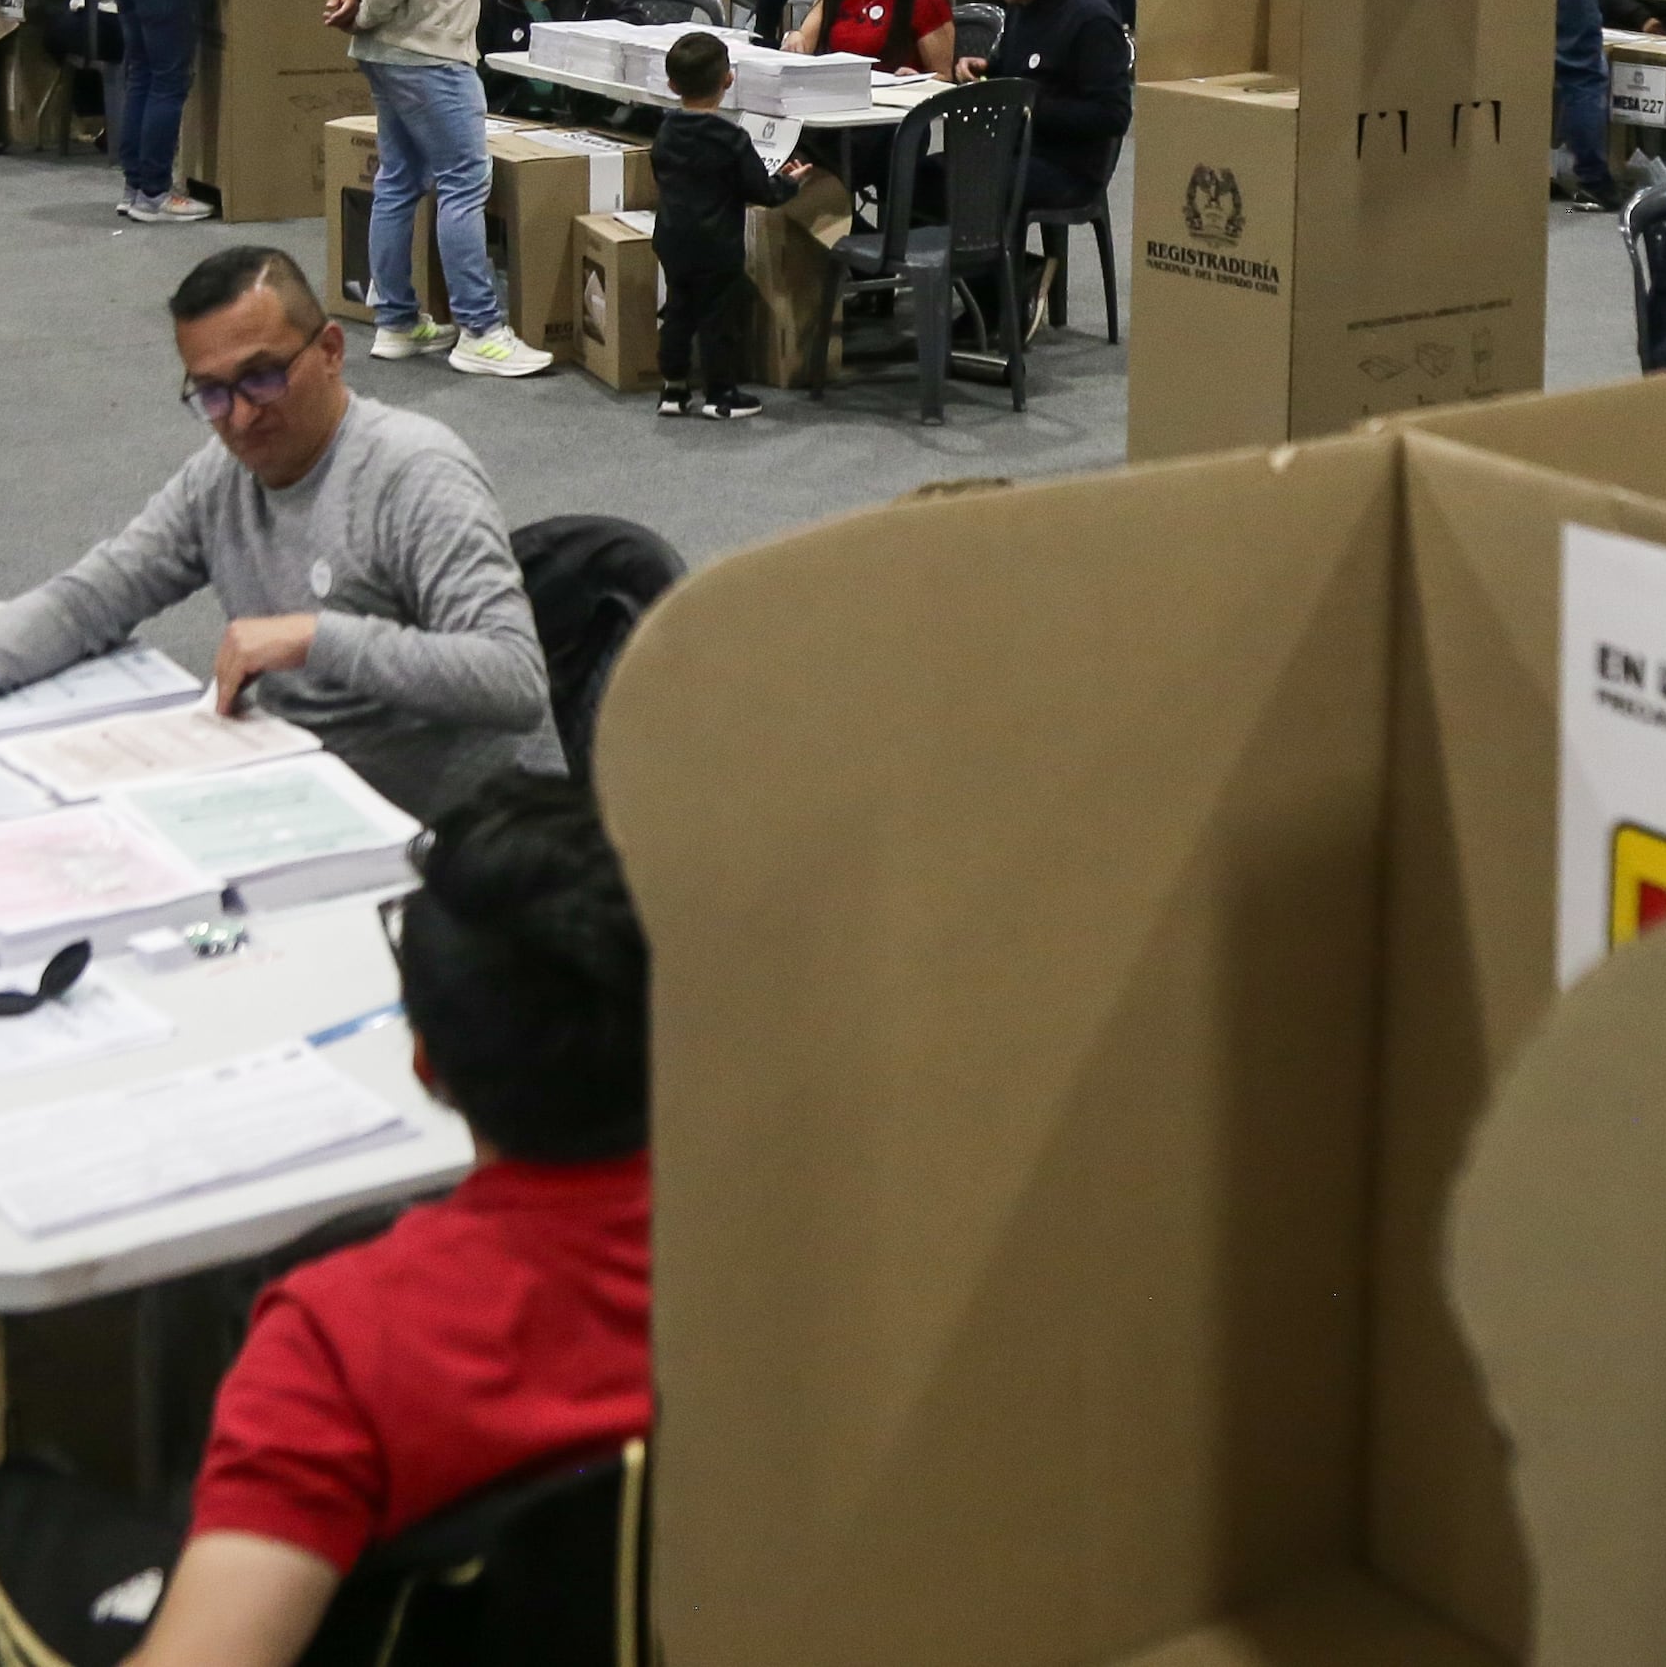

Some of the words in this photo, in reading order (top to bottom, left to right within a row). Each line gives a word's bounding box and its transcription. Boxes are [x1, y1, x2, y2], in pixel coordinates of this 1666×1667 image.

[1613, 95, 1640, 112] MESA
[1641, 98, 1664, 114] 227
[1146, 258, 1191, 277] NACIONAL
[1195, 269, 1212, 281] DEL
[1216, 273, 1254, 290] ESTADO
[1255, 282, 1278, 295] CIVIL
[1147, 240, 1280, 284] REGISTRADURÍA
[1597, 640, 1647, 691] EN
